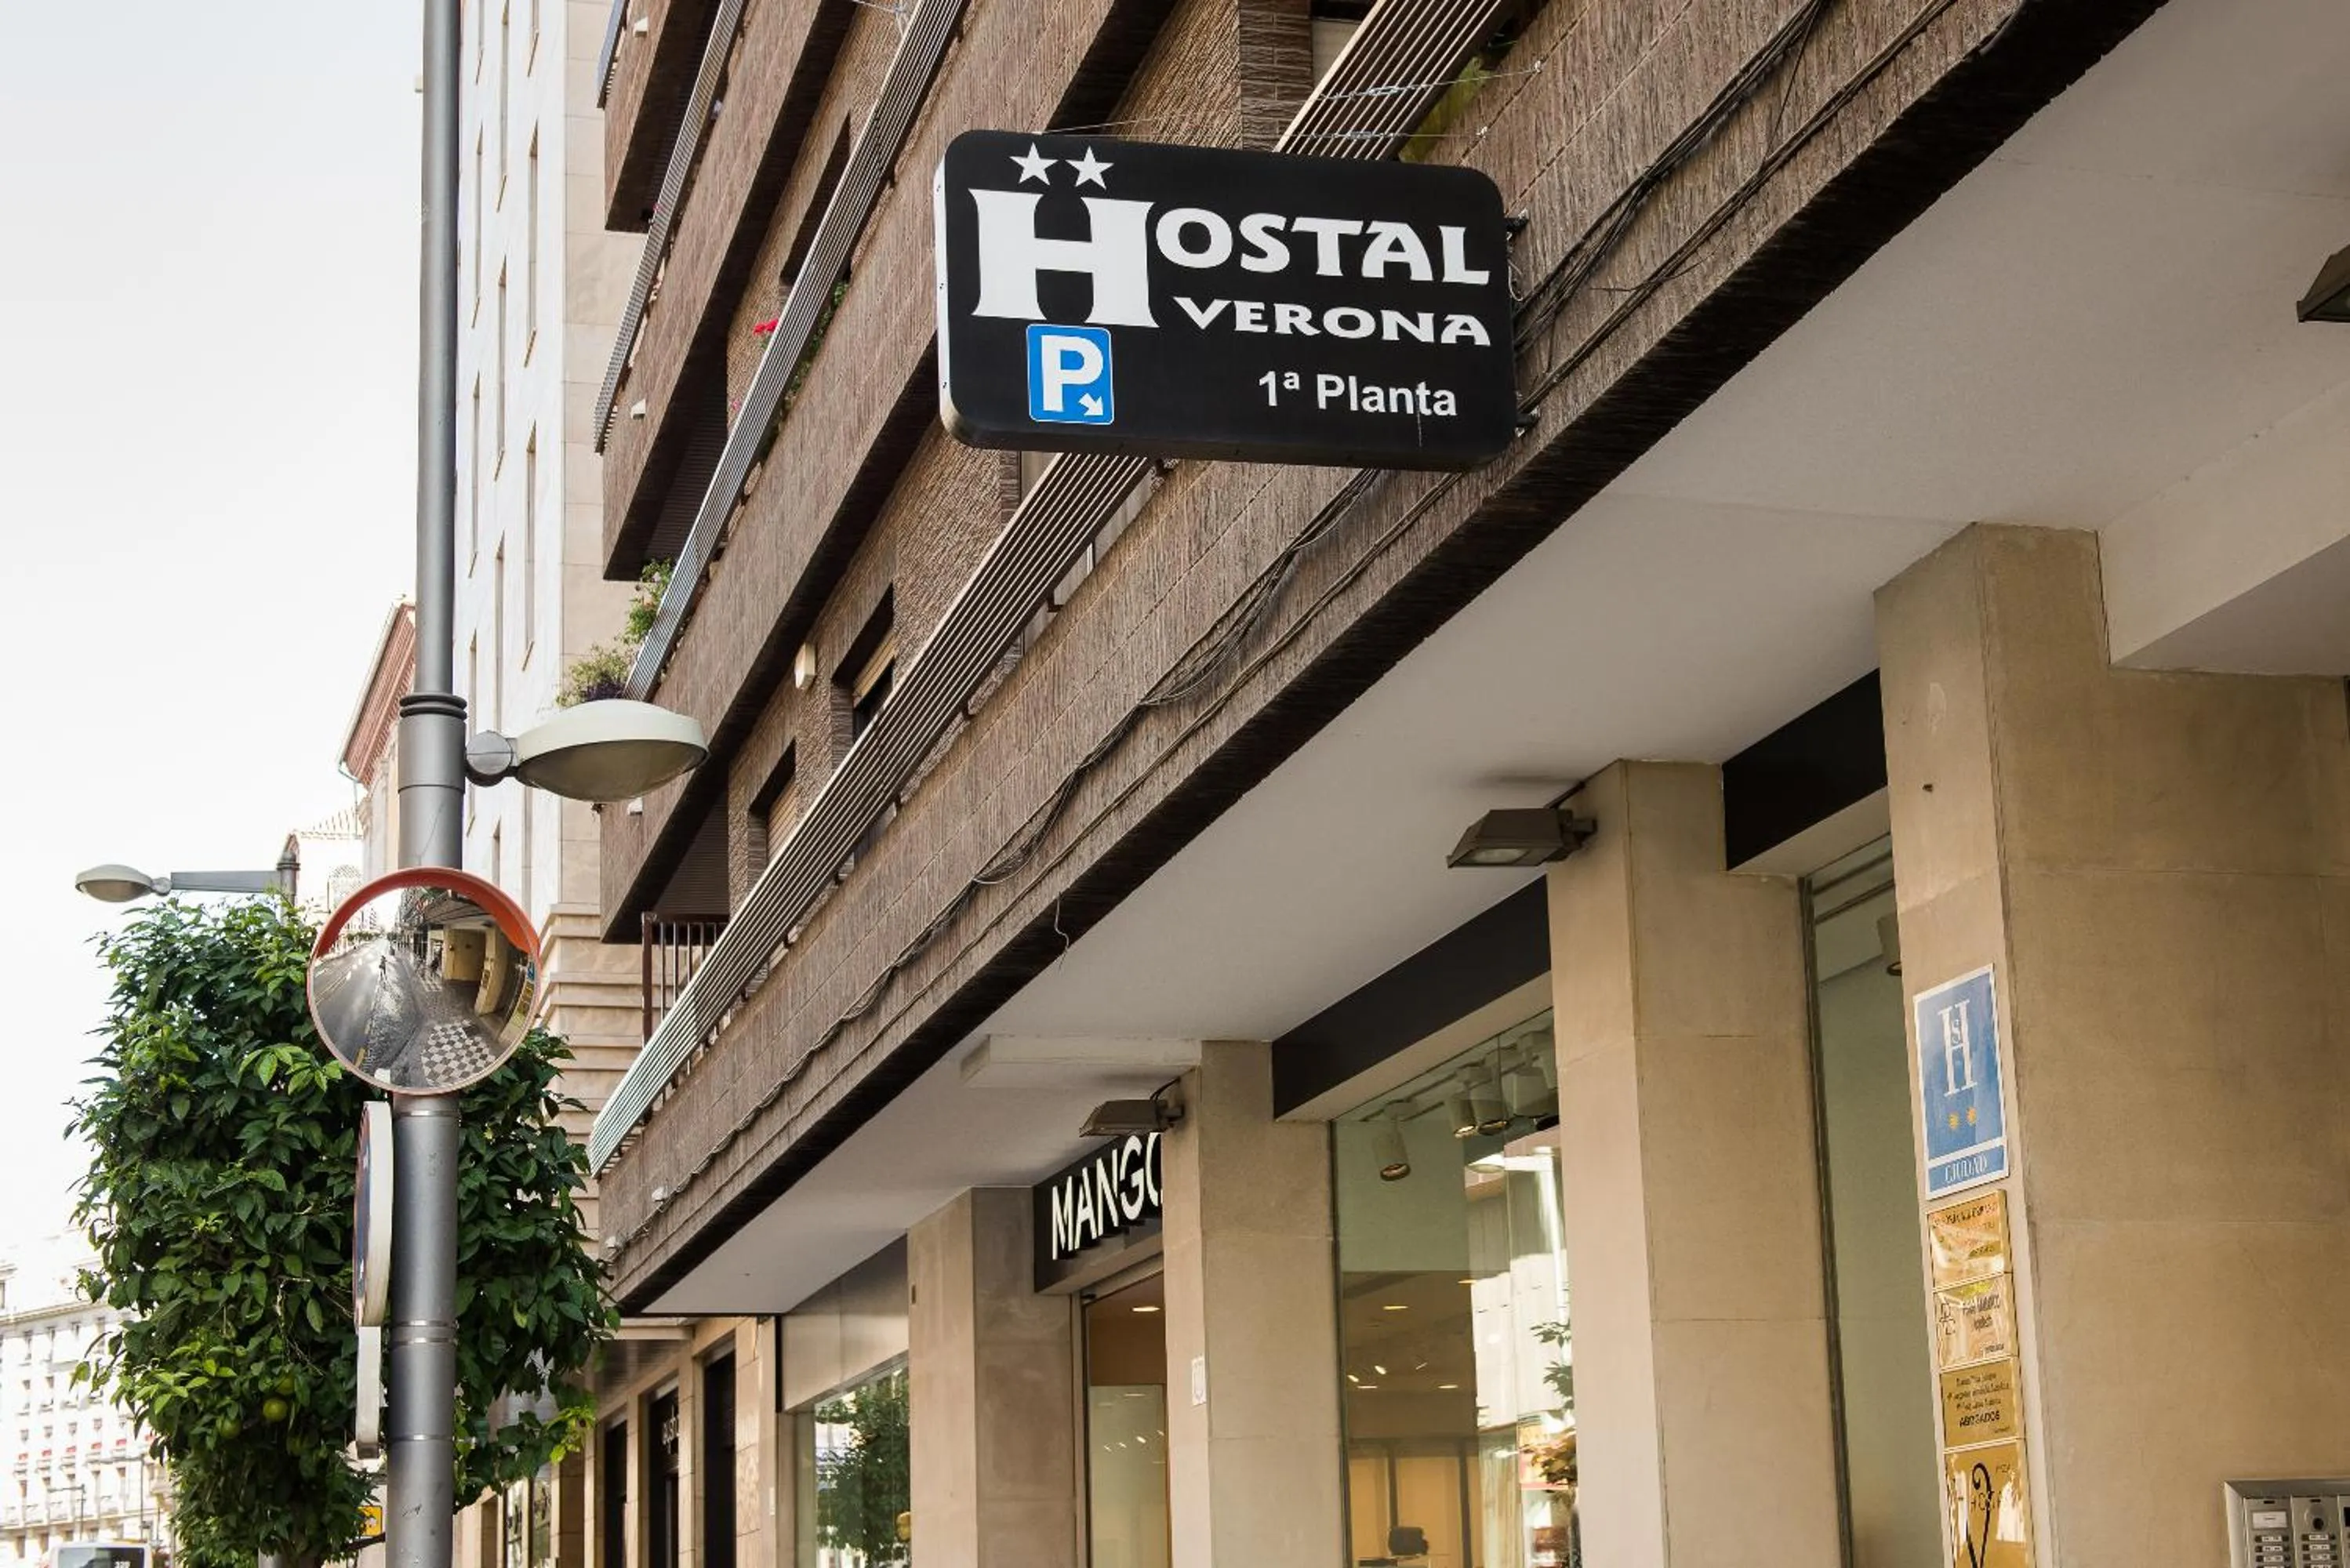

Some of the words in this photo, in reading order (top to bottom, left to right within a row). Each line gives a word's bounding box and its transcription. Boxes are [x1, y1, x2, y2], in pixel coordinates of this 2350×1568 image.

[968, 187, 1490, 328] HOSTAL
[1173, 296, 1491, 347] VERONA
[1041, 334, 1104, 412] P
[1317, 374, 1458, 417] Planta
